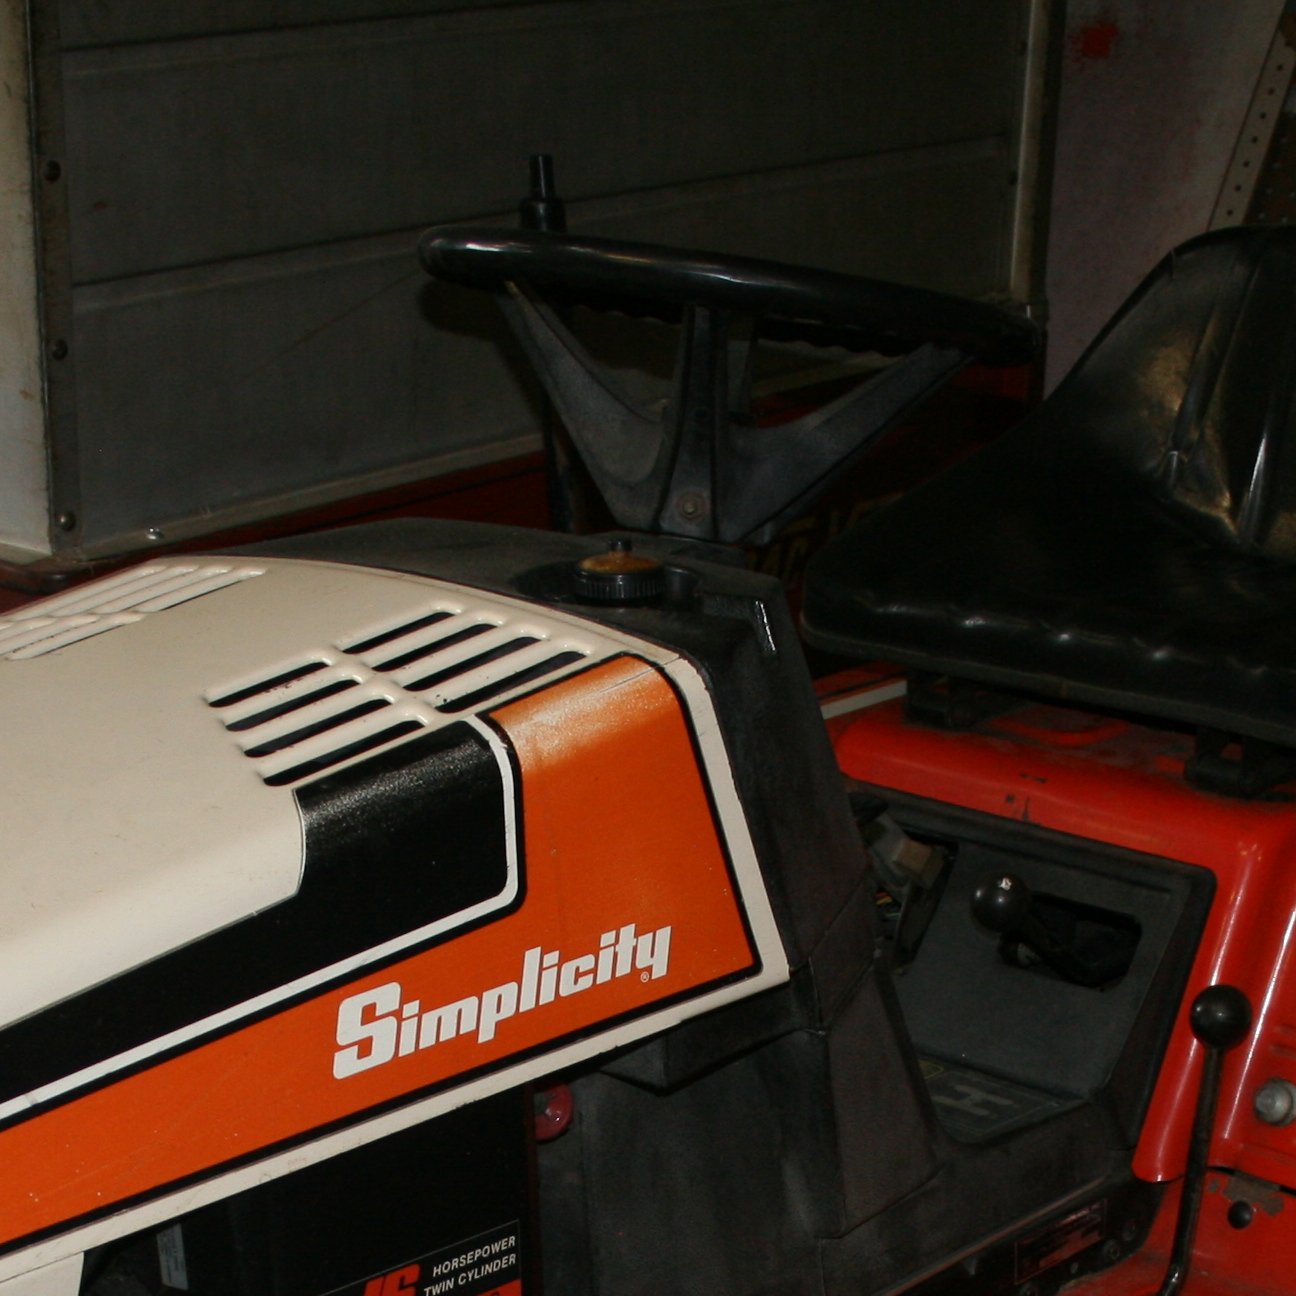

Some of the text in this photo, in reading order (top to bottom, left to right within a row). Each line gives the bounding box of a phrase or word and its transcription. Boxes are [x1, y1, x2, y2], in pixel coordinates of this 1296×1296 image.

[332, 922, 673, 1081] Simplicity
[432, 1235, 517, 1278] HORSEPOWER
[458, 1253, 517, 1287] CYLINDER
